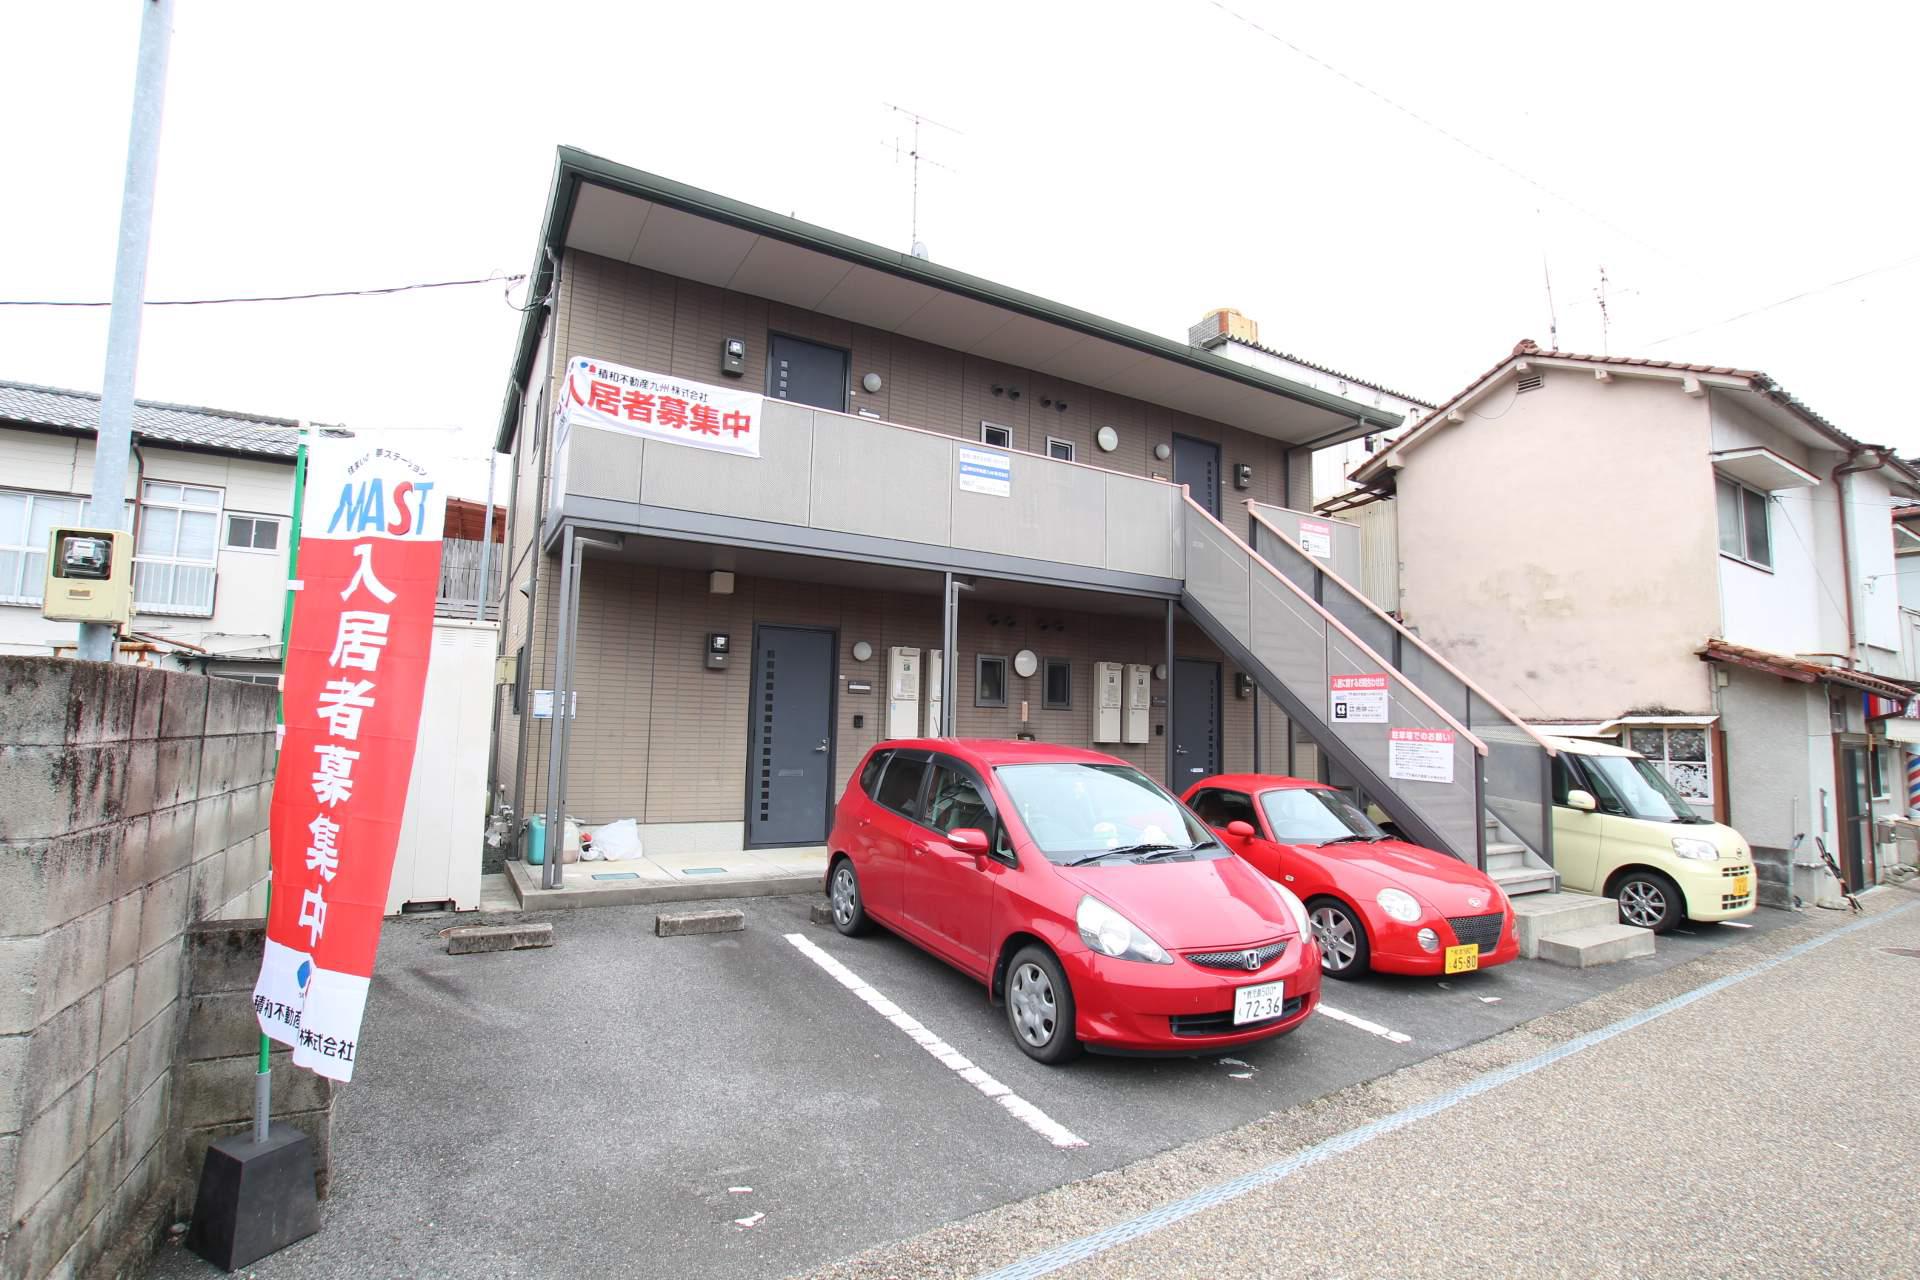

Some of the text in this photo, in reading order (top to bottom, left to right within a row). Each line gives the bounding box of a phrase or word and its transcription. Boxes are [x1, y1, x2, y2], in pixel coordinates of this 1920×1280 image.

[565, 373, 751, 438] 入居者募集中
[327, 477, 434, 536] MAST
[298, 543, 398, 949] 入居者募集中
